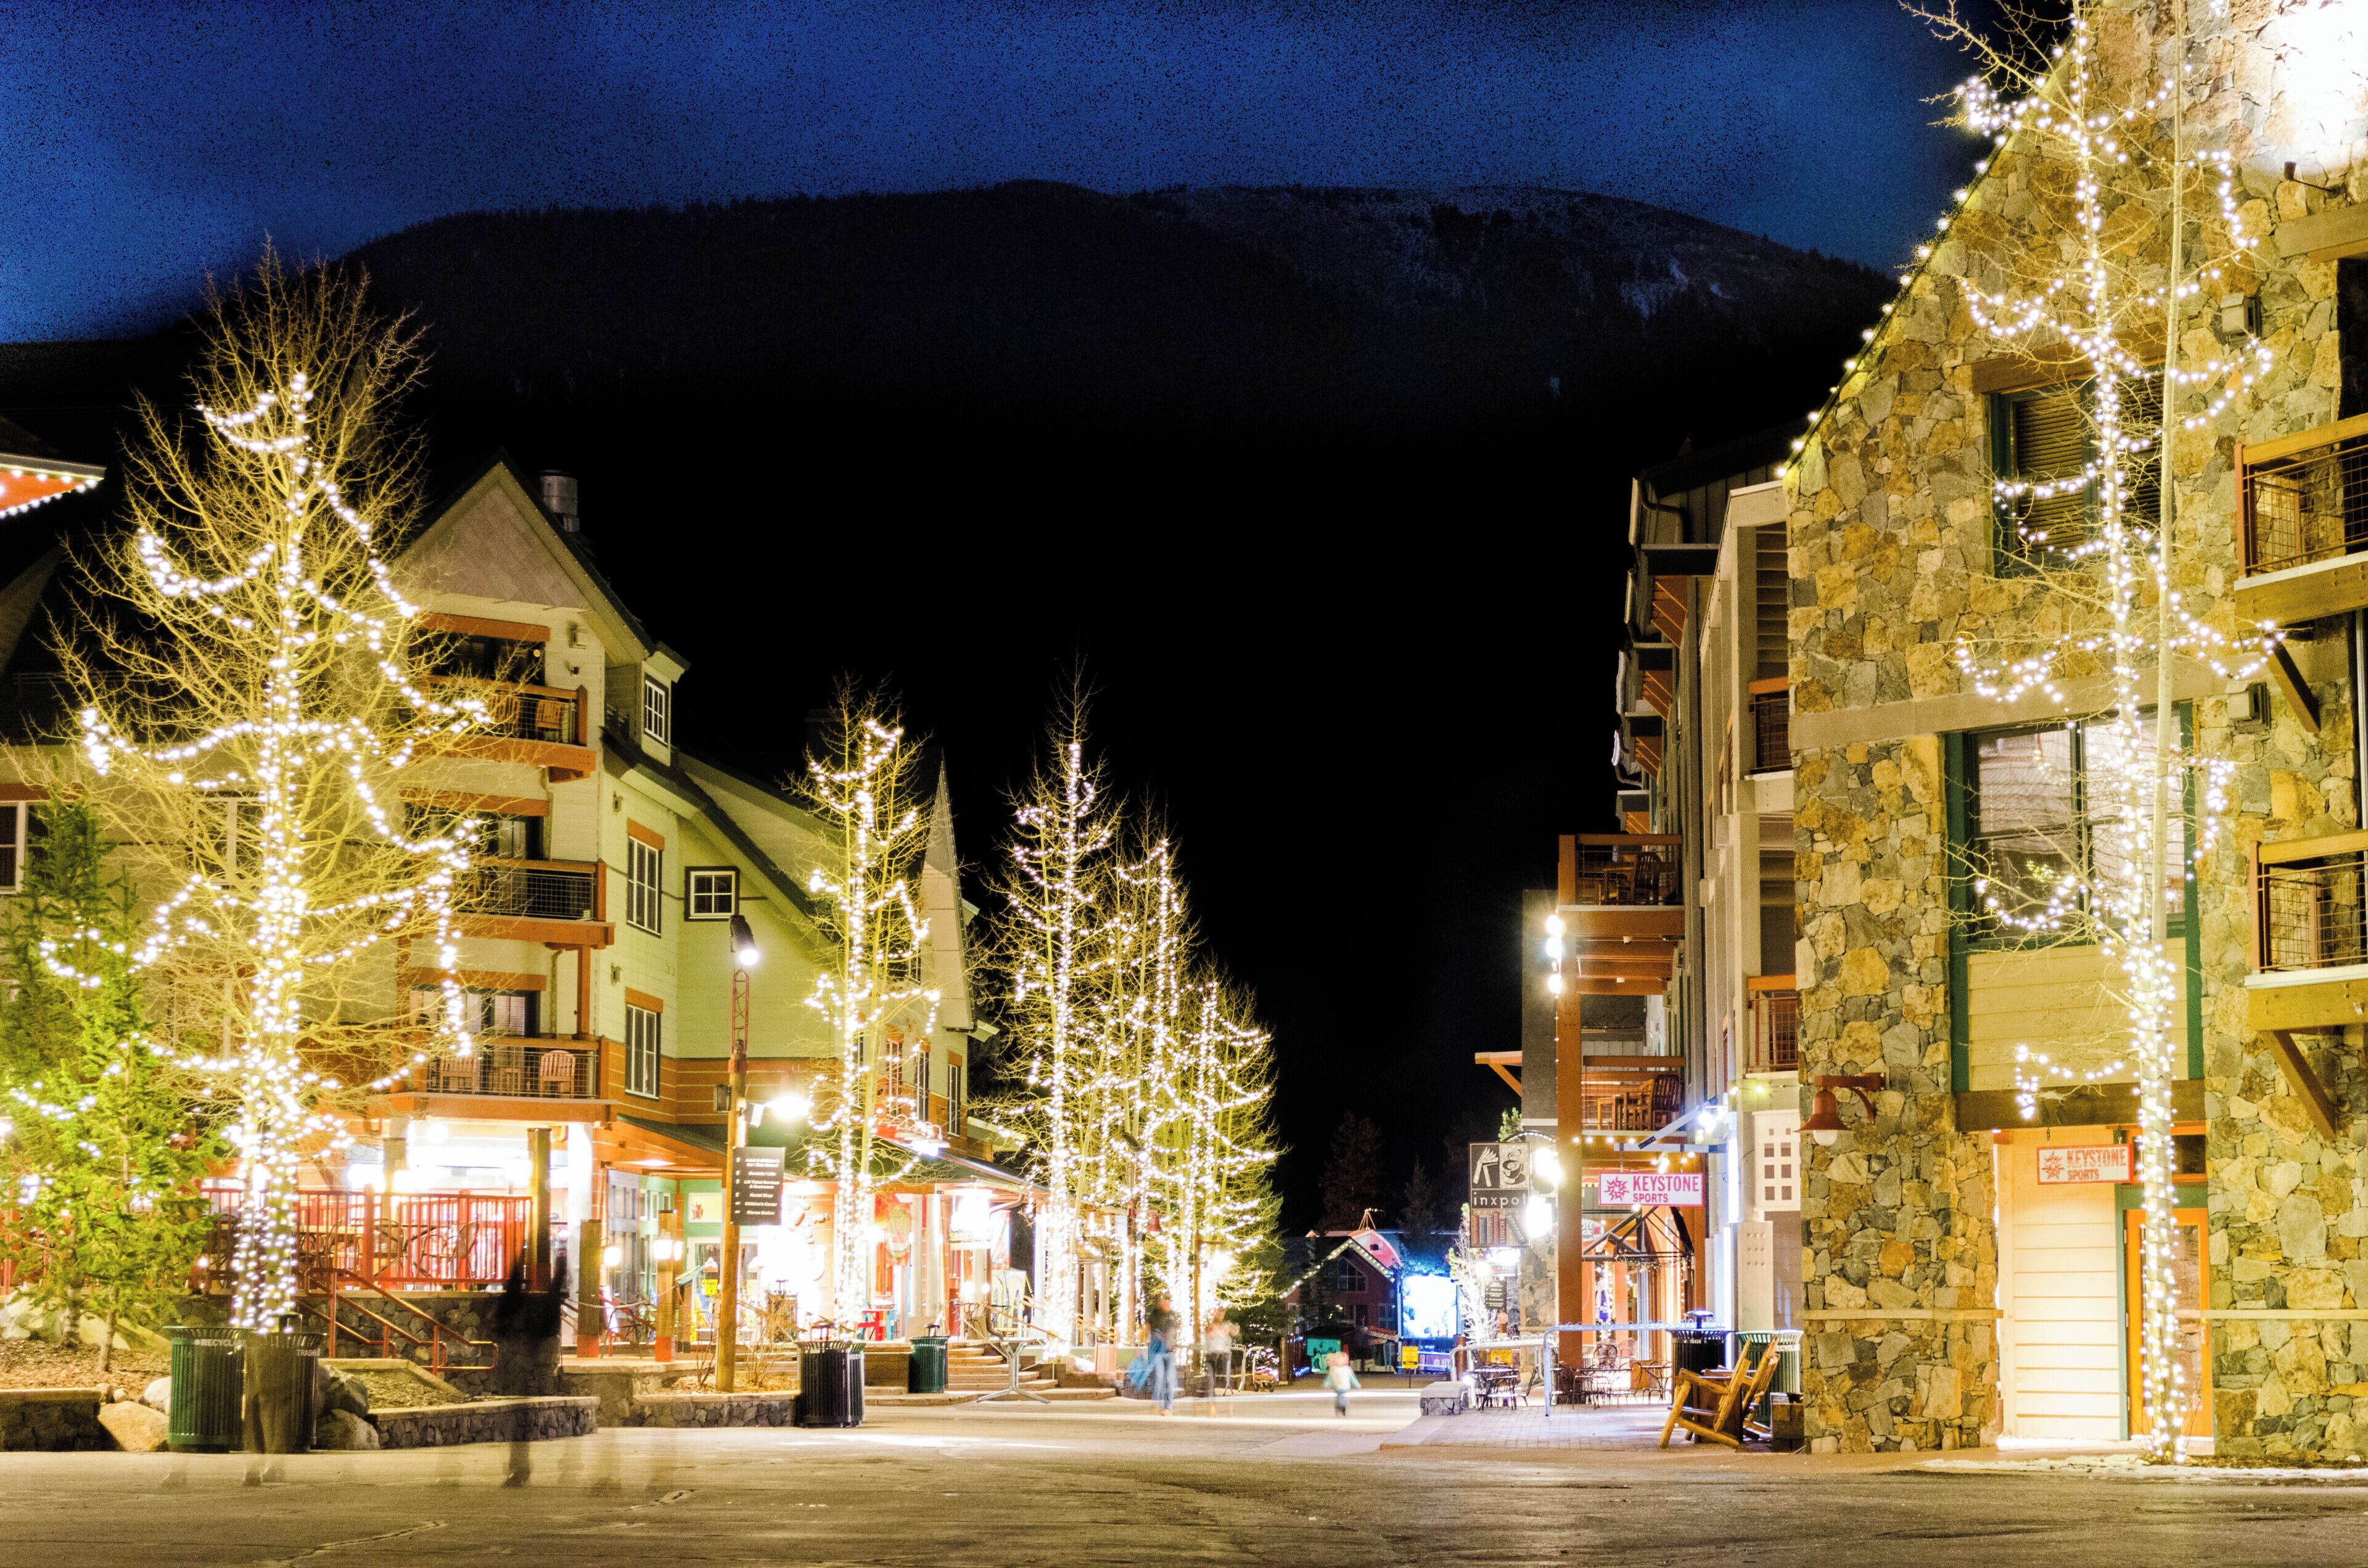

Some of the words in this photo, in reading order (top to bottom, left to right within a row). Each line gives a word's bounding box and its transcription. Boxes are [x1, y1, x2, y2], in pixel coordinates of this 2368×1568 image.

[2066, 1149, 2126, 1168] KEYSTONE
[2067, 1168, 2100, 1180] SPORTS
[1633, 1176, 1699, 1192] KEYSTONE
[1474, 1191, 1526, 1209] inxpot
[1633, 1193, 1669, 1203] SPORTS
